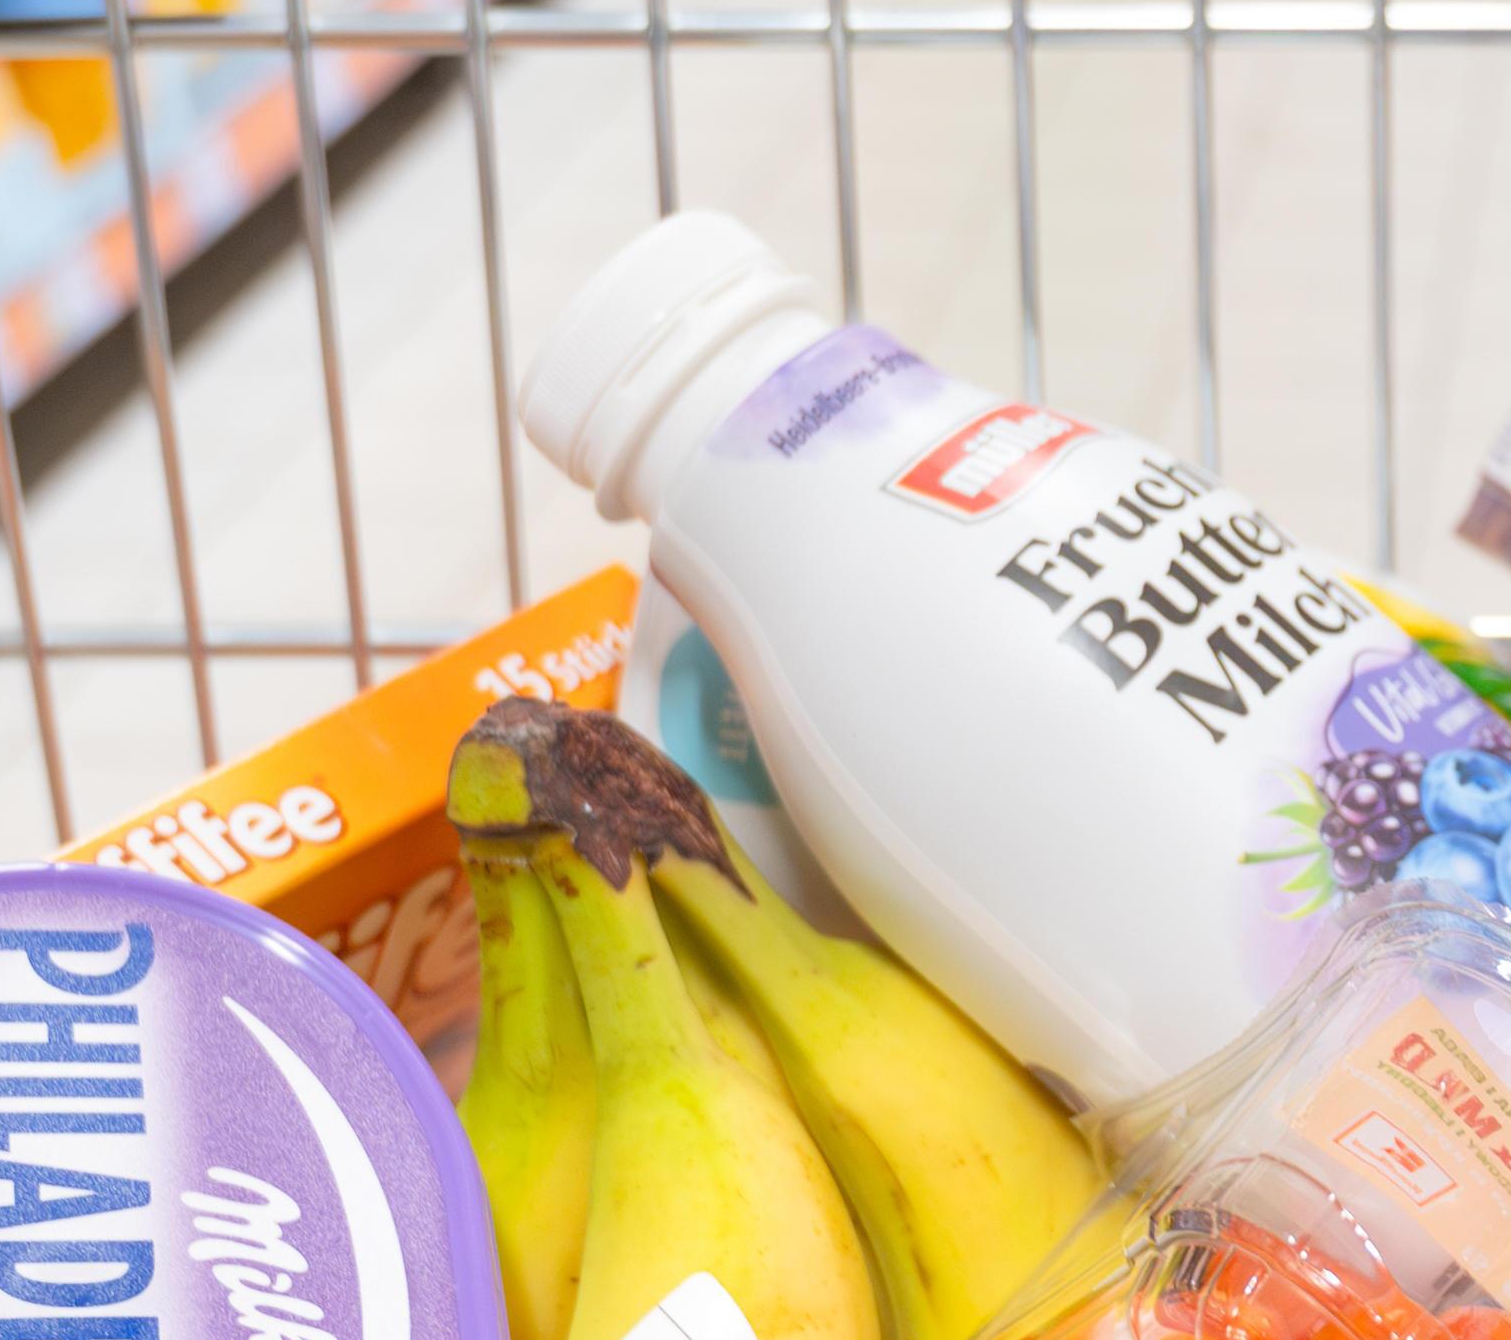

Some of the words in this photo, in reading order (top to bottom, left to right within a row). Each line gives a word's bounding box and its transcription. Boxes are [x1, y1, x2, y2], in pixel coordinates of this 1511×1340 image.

[996, 458, 1225, 614] Fruch
[1057, 510, 1296, 692] Butte
[473, 652, 554, 702] 15
